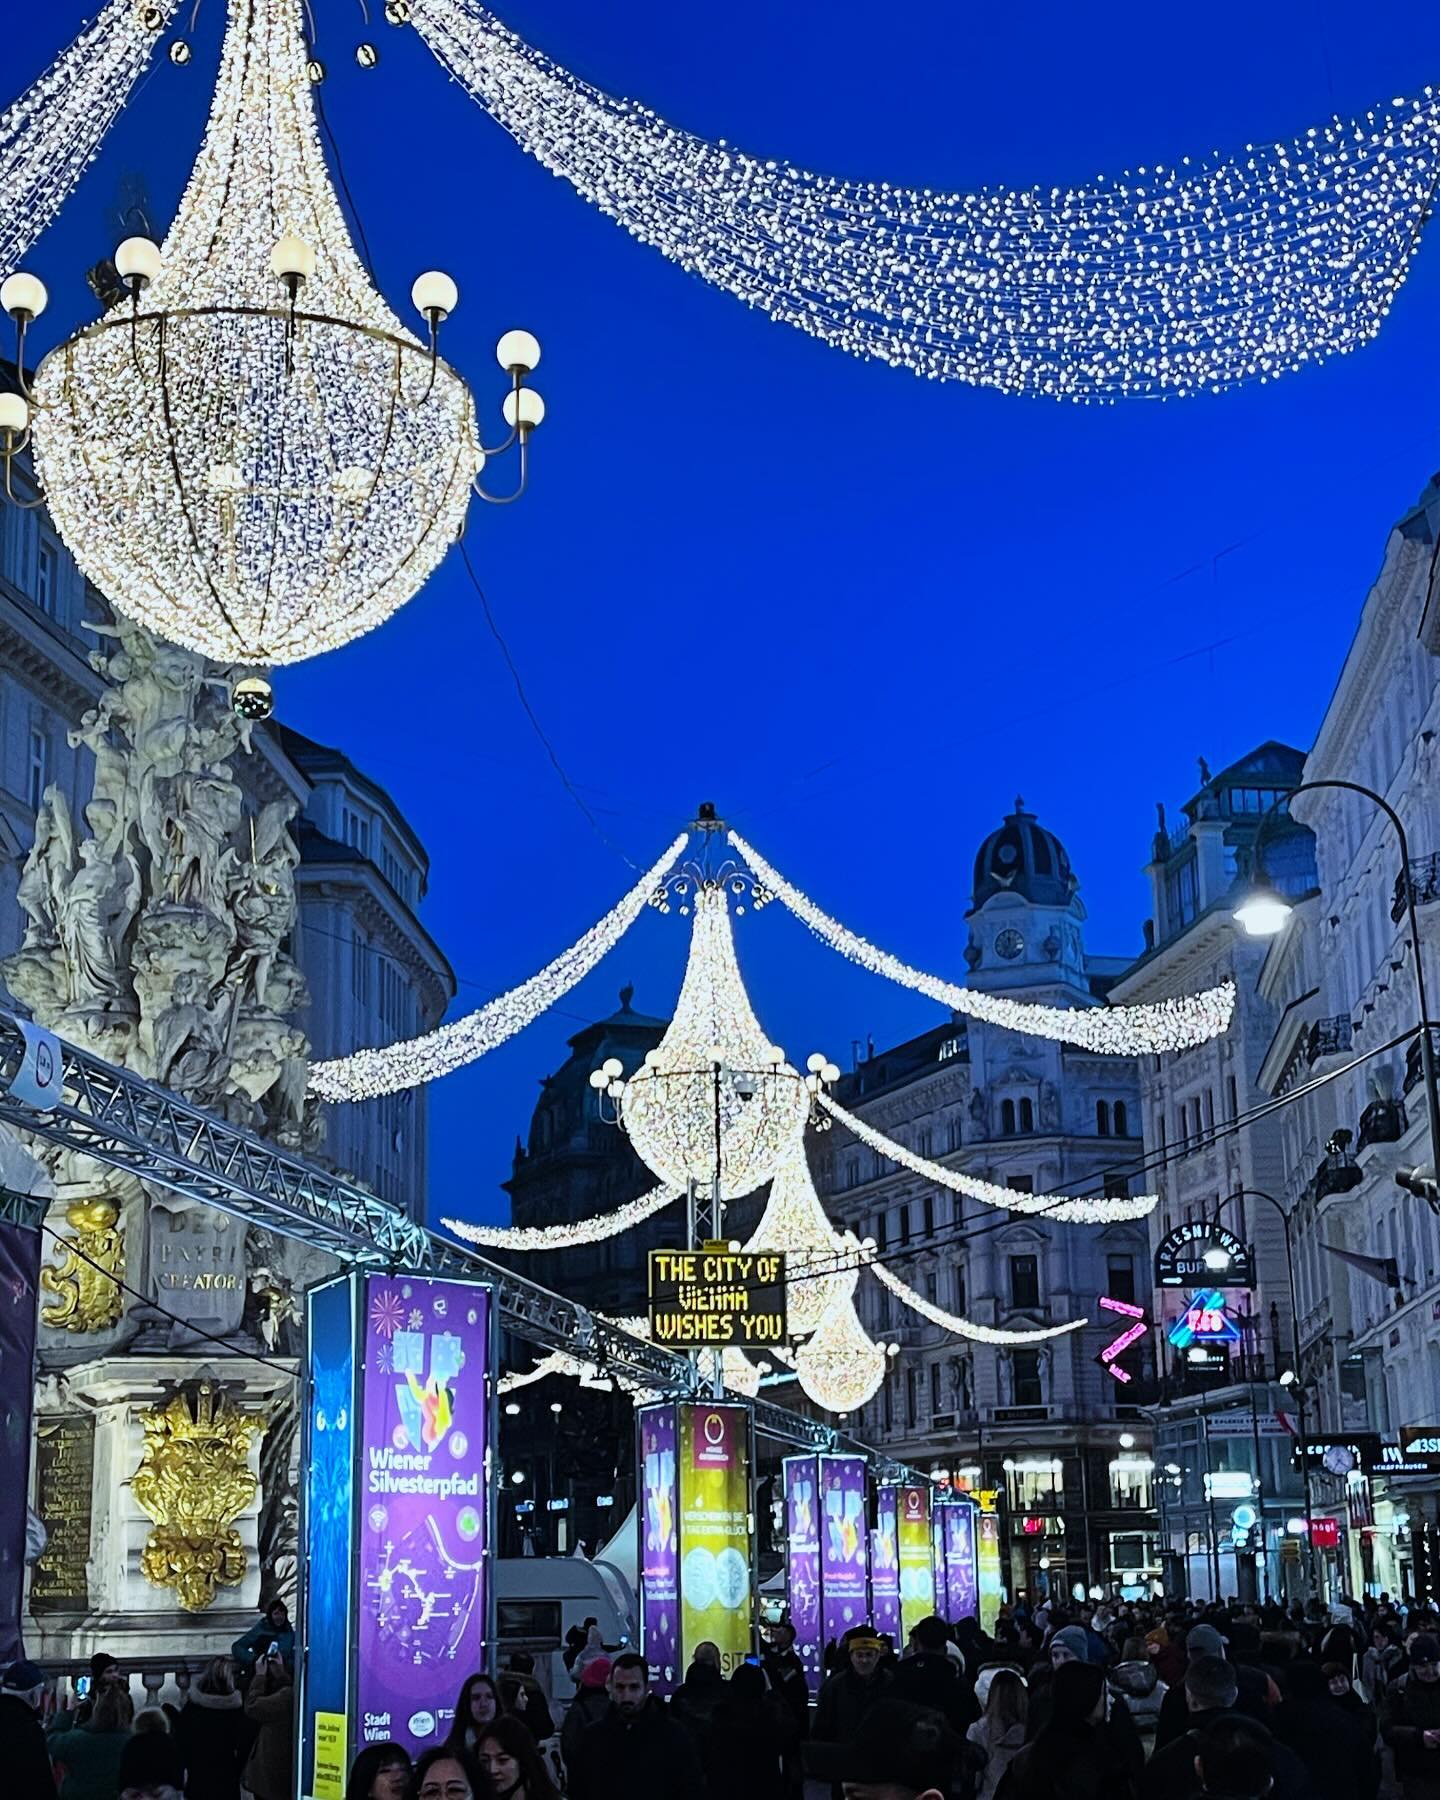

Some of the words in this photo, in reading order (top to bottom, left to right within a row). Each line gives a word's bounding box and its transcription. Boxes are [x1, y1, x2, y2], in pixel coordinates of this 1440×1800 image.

[655, 1255, 697, 1282] THE
[703, 1255, 752, 1282] CITY
[757, 1255, 780, 1283] OF
[655, 1313, 733, 1340] WISHES
[740, 1313, 782, 1340] YOU
[369, 1446, 432, 1471] Wiener
[368, 1470, 478, 1500] Silvesterpfad
[363, 1711, 391, 1727] Stadt
[363, 1727, 391, 1742] Wien
